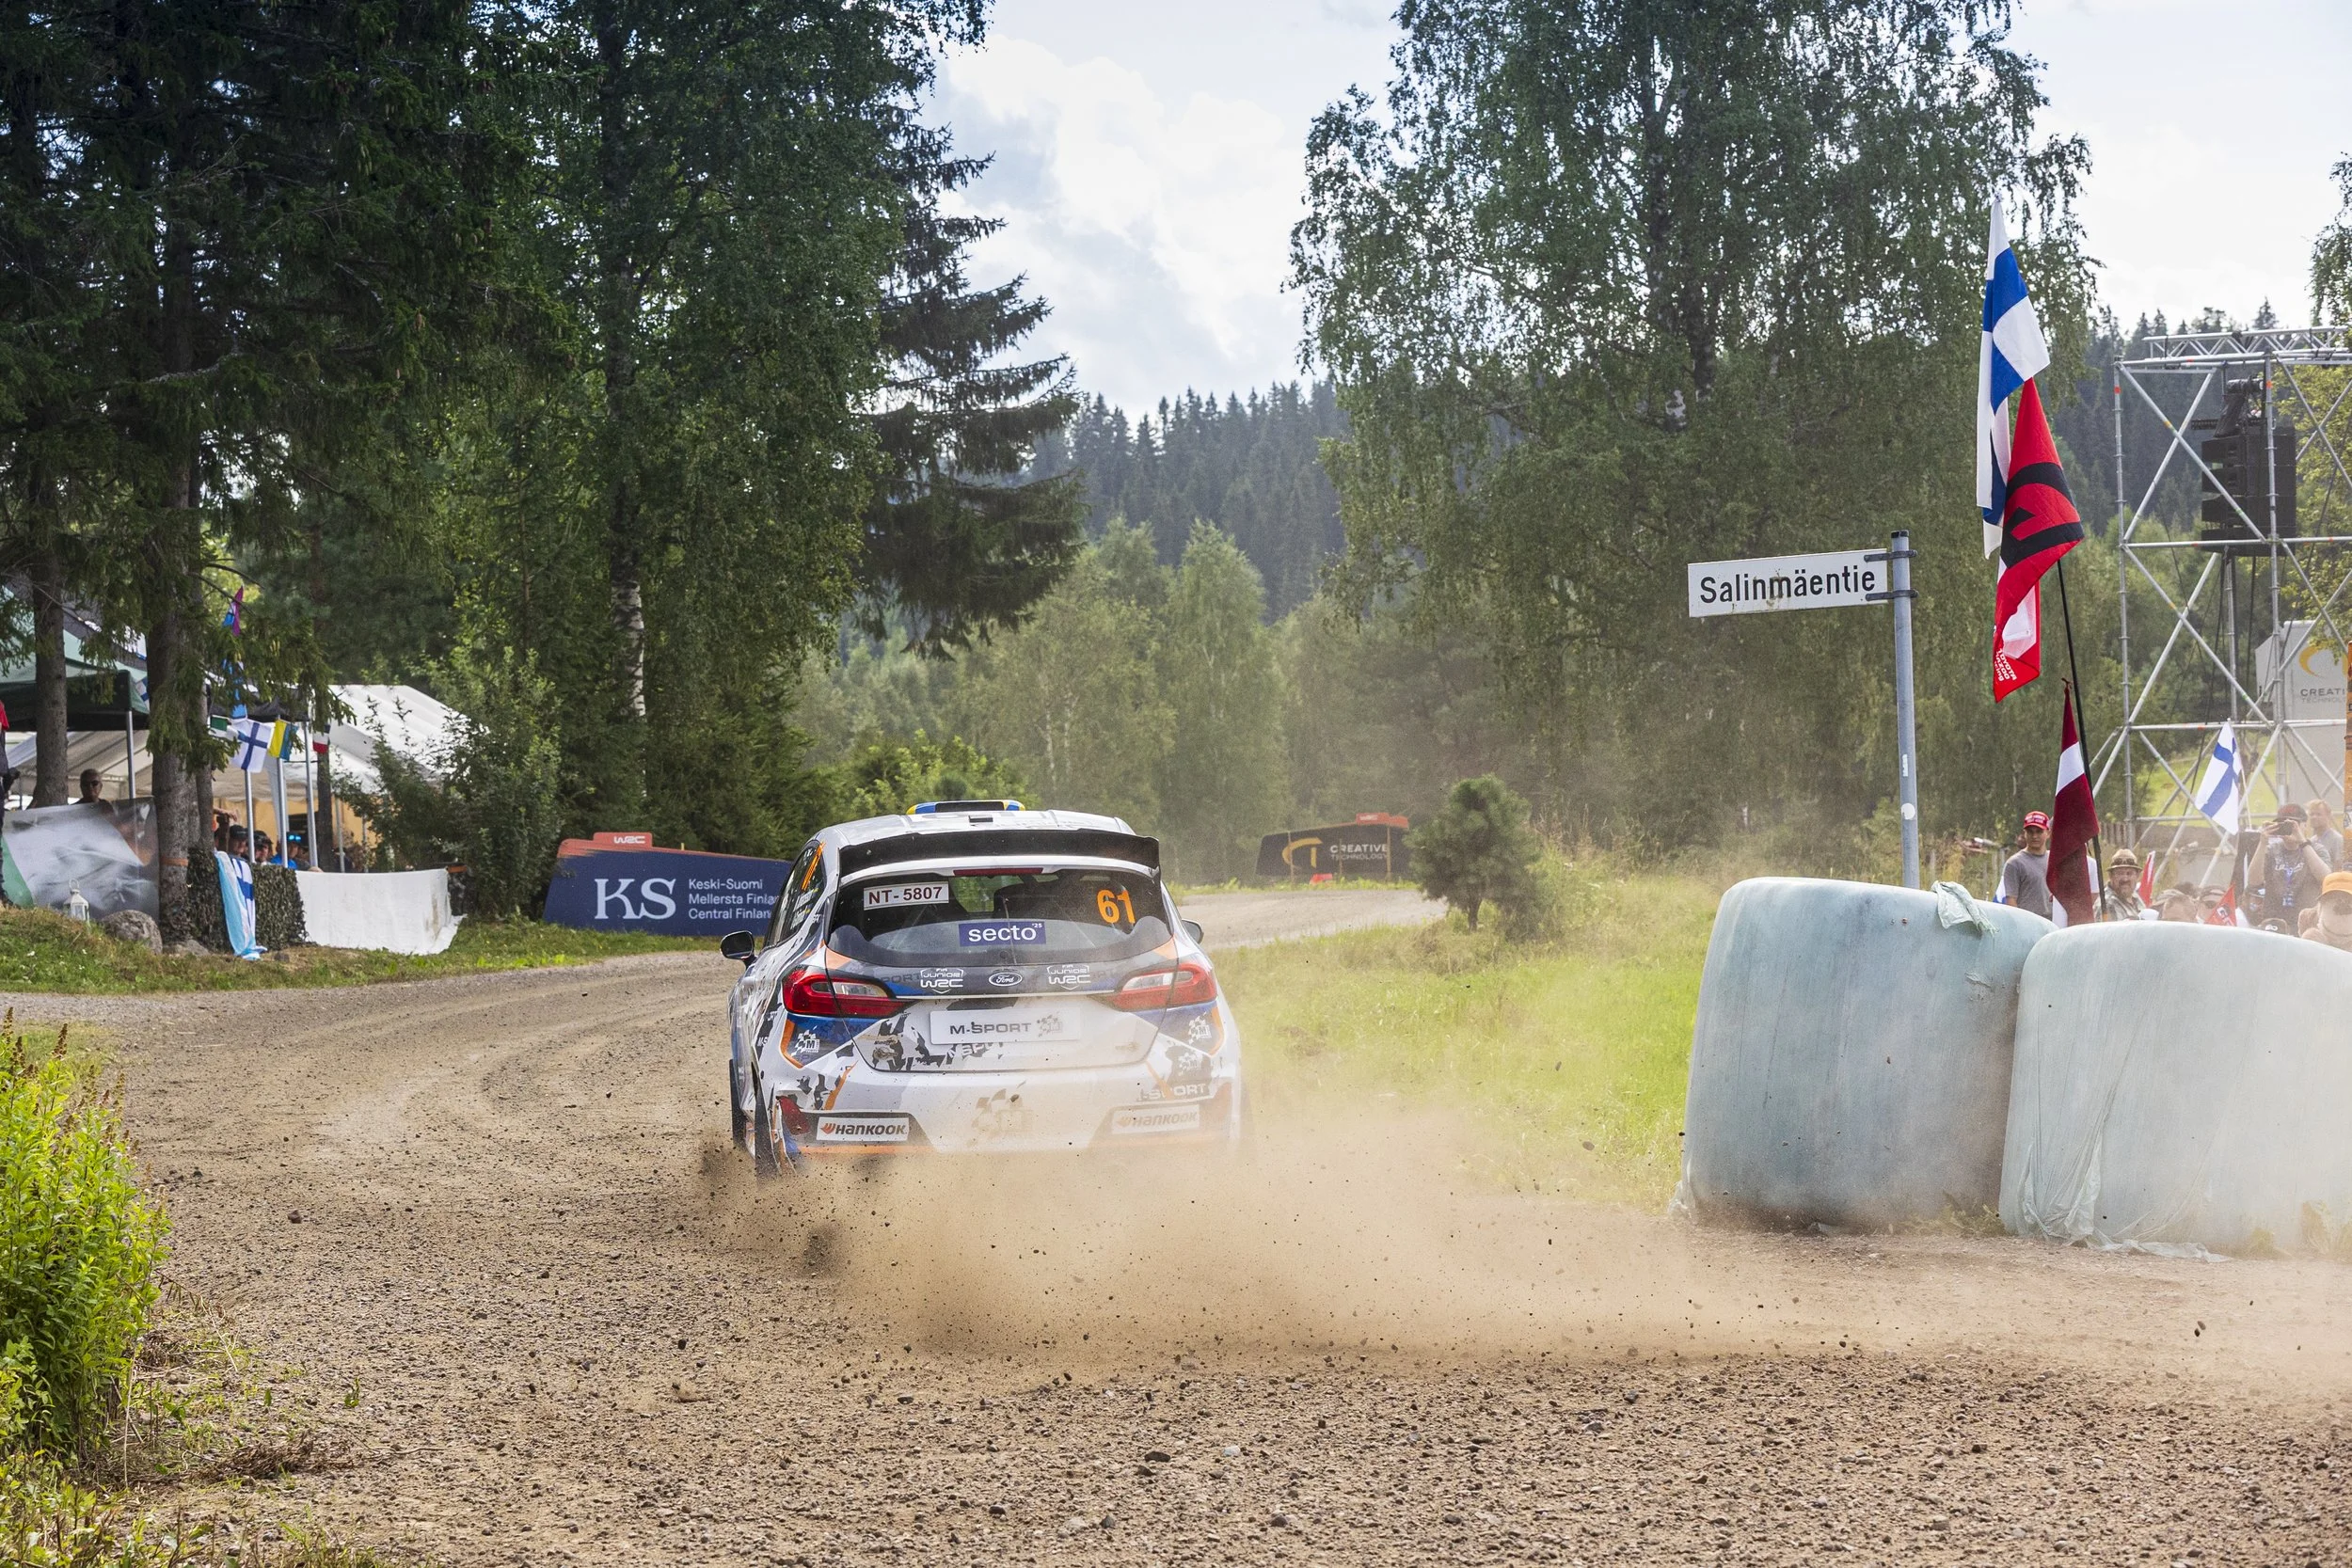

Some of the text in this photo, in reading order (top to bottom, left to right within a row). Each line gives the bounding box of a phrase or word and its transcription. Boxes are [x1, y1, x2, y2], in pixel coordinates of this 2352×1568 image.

[1700, 565, 1875, 603] Salinmäentie
[1997, 648, 2017, 681] TOYOTA
[2300, 688, 2344, 697] CREATI
[613, 835, 646, 845] WRC
[1329, 844, 1389, 853] CREATIVE
[689, 879, 763, 890] Keski-Suomi
[594, 878, 676, 920] KS
[689, 894, 780, 905] Mellersta Finla
[1096, 889, 1136, 924] 61
[689, 909, 771, 919] Central Finlan
[968, 924, 1037, 942] secto
[920, 978, 964, 989] WRC
[995, 974, 1015, 984] Ford
[1048, 974, 1091, 984] WRC
[950, 1022, 1032, 1035] M-SPORT
